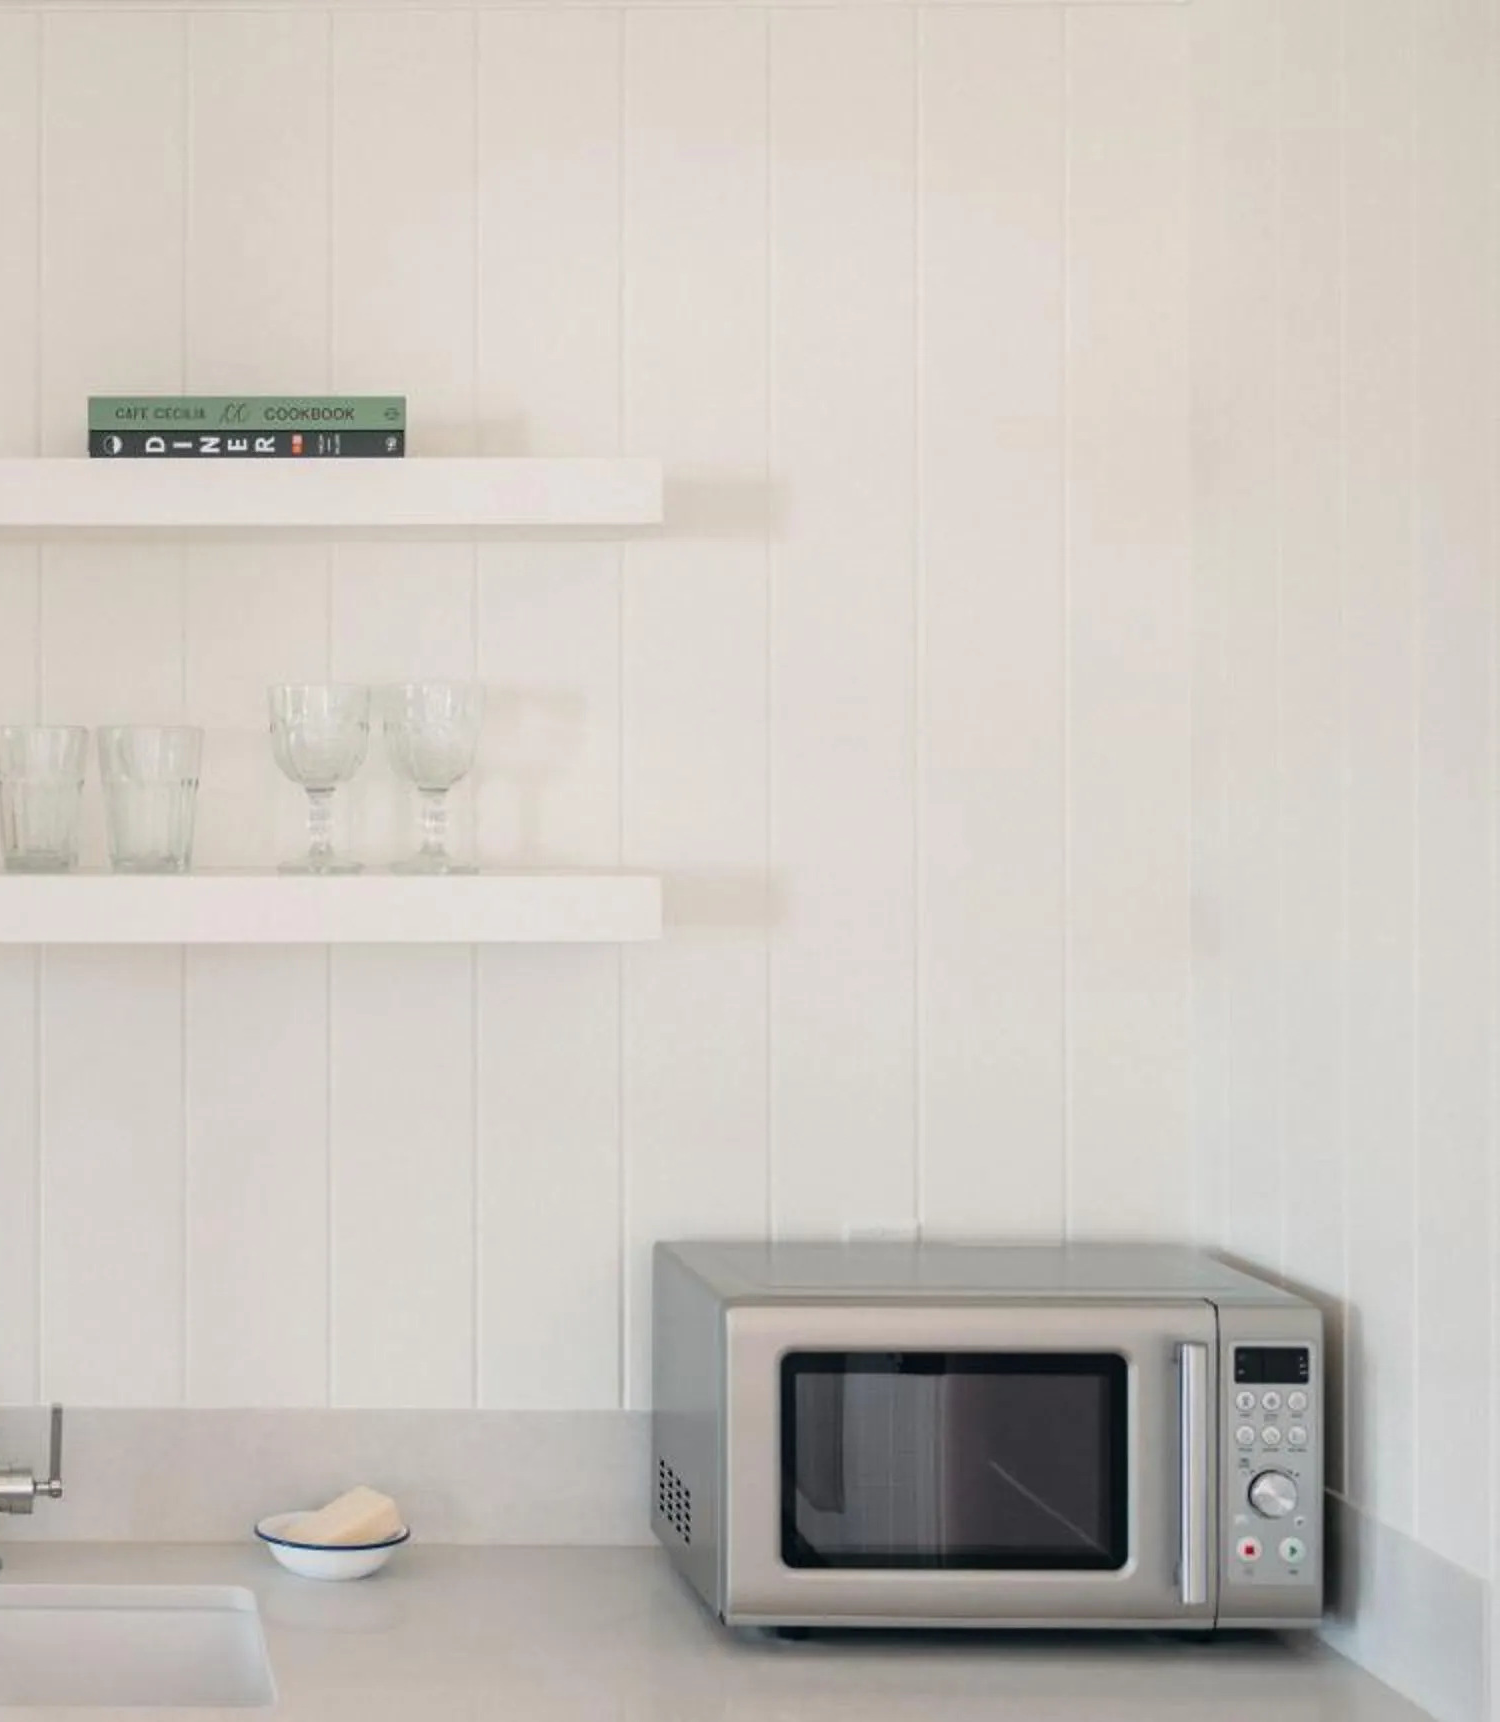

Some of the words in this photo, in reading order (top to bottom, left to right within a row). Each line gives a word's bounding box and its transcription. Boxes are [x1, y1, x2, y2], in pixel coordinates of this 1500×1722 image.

[154, 406, 206, 420] CECILIA
[263, 407, 355, 421] COOKBOOK
[145, 436, 275, 453] DINER
